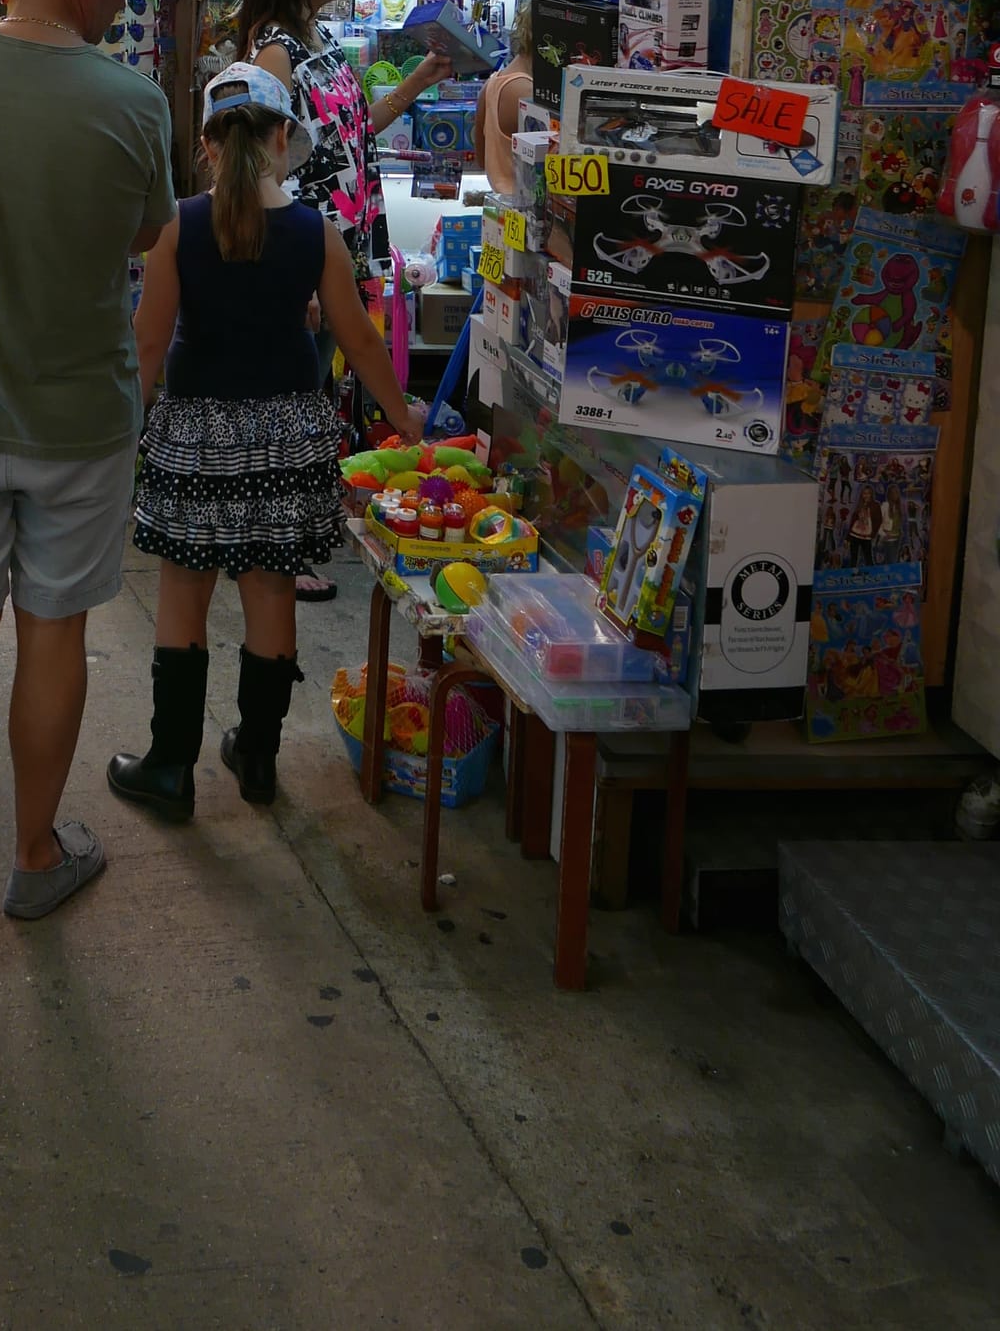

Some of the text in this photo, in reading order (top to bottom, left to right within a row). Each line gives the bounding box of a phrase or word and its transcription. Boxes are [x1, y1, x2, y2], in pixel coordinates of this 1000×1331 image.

[718, 92, 794, 131] SALE
[645, 176, 684, 193] AXIS
[689, 181, 739, 198] GYRO
[580, 301, 596, 317] 6
[593, 304, 630, 321] AXIS
[630, 308, 673, 326] GYRO
[764, 326, 780, 335] 14+
[482, 338, 500, 359] Black
[855, 353, 922, 367] Sticker
[575, 405, 613, 419] 3388-1
[737, 562, 783, 581] METAL
[736, 600, 783, 620] SERIES
